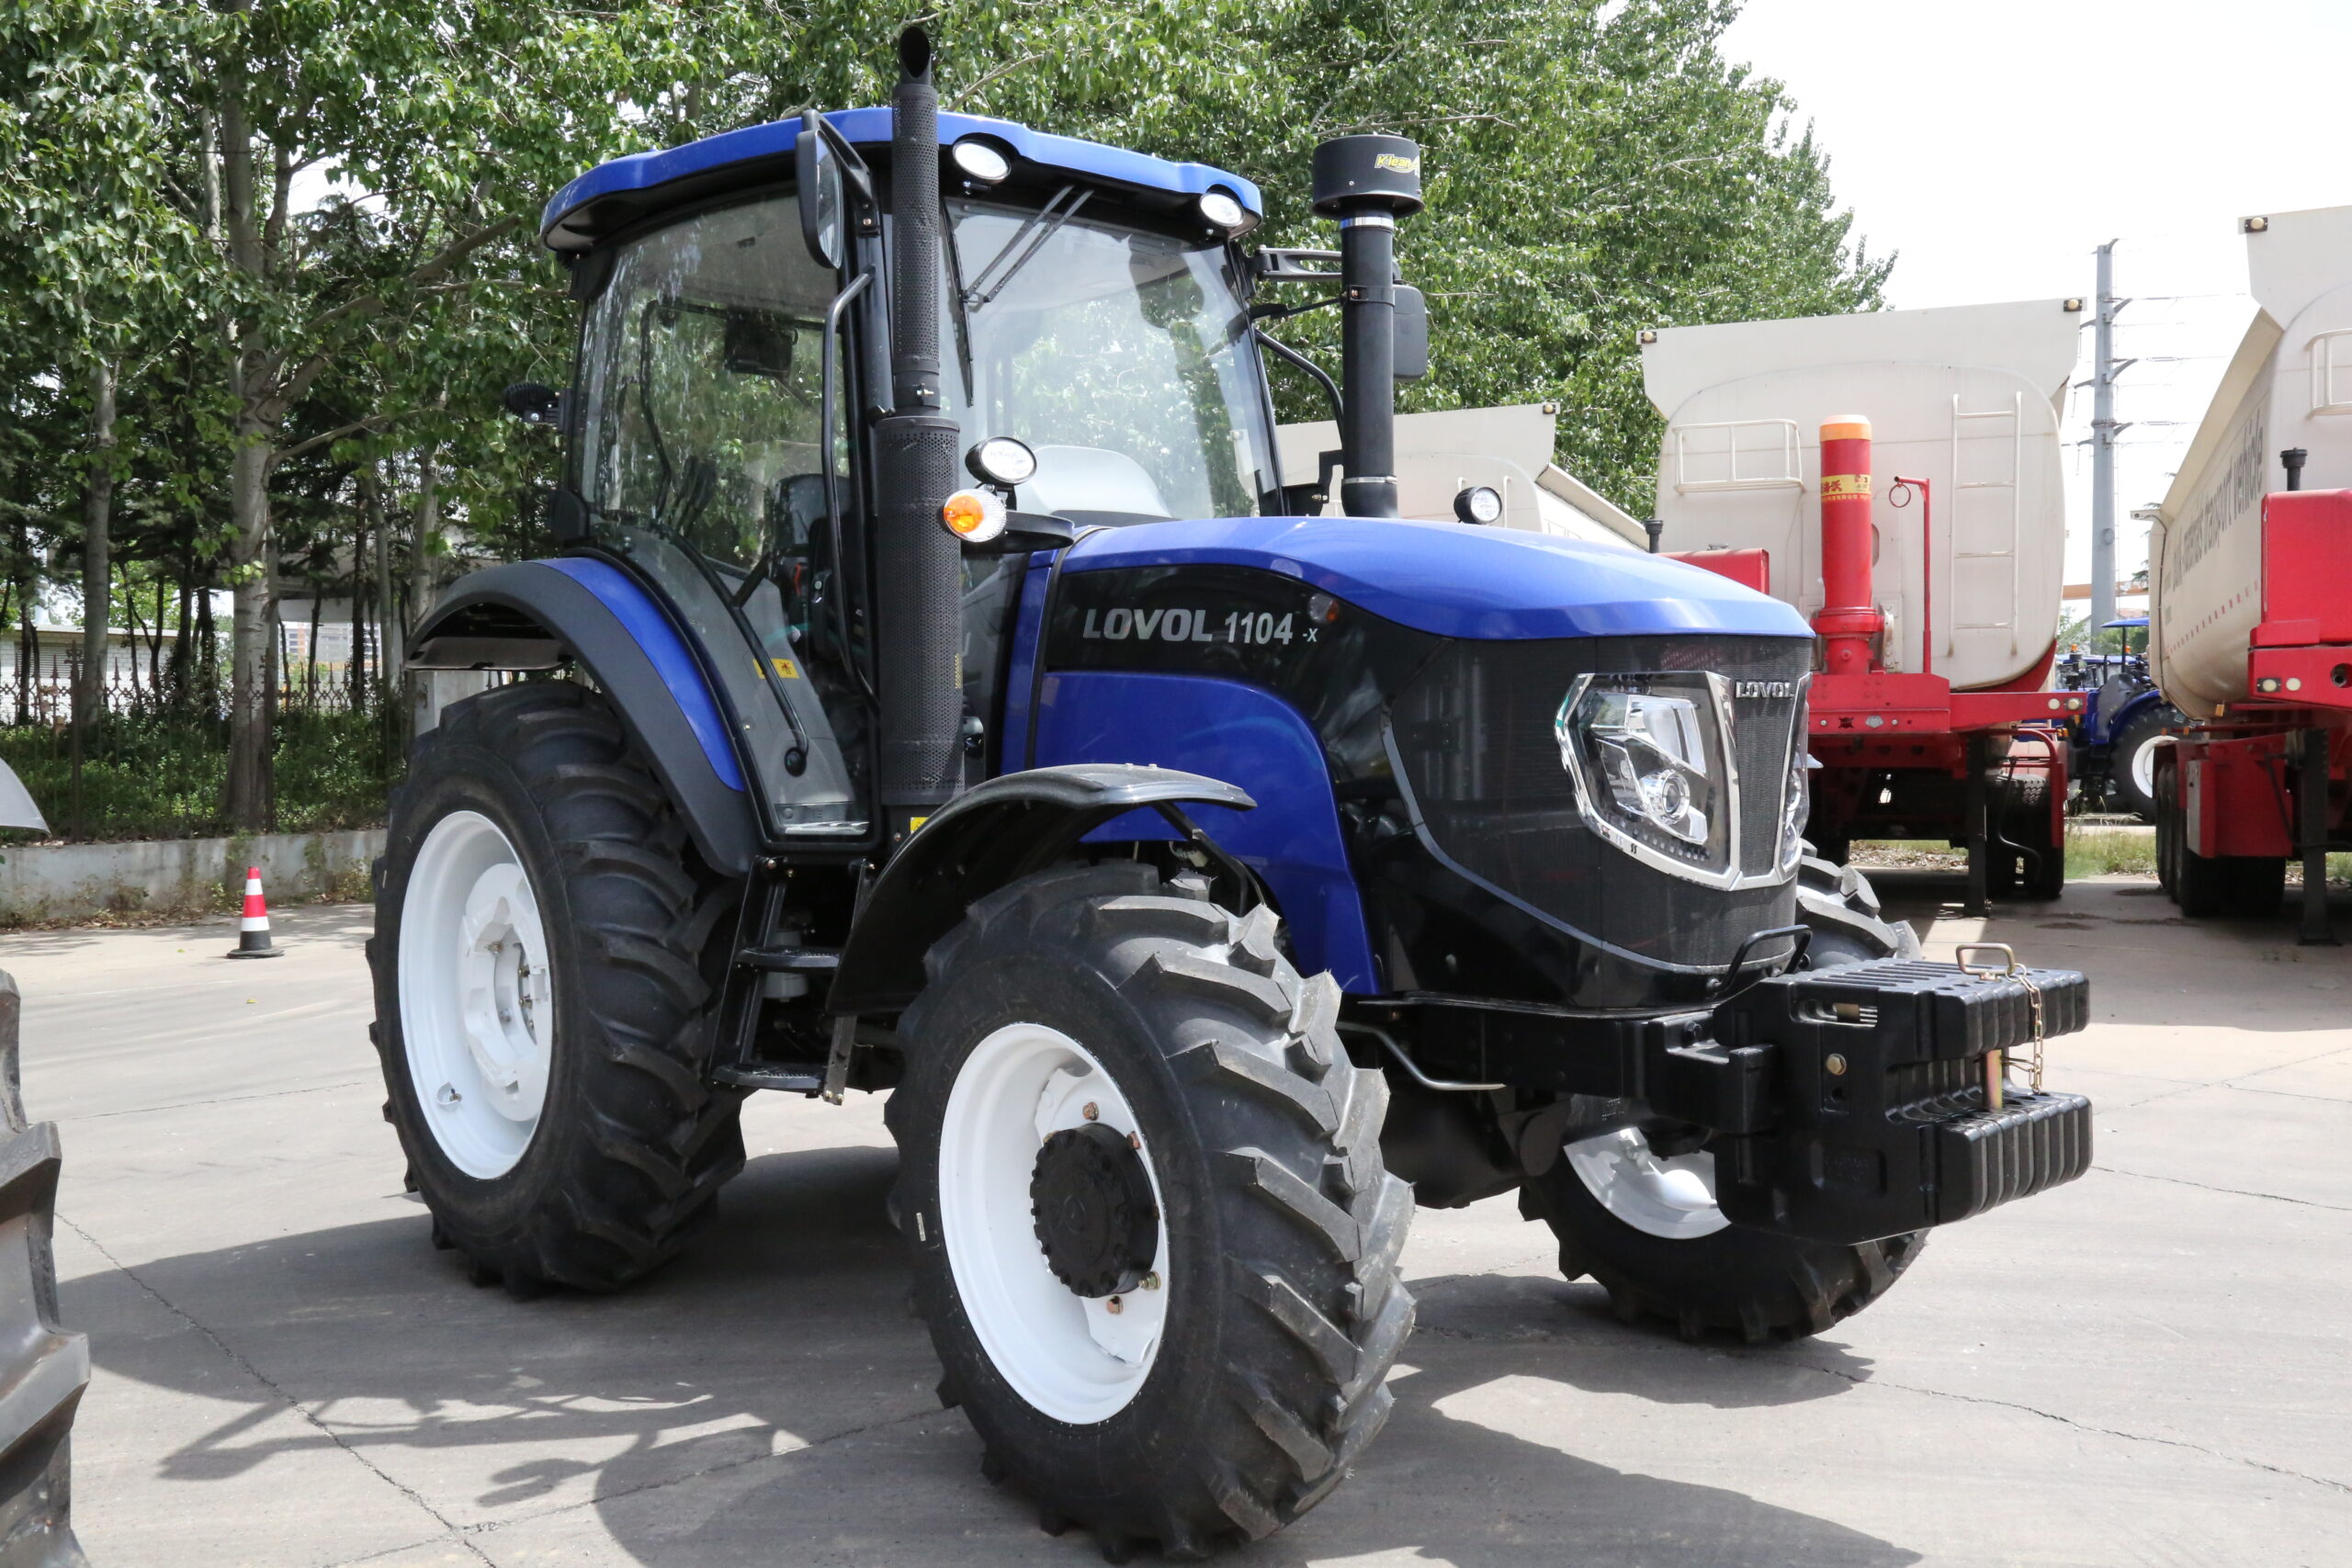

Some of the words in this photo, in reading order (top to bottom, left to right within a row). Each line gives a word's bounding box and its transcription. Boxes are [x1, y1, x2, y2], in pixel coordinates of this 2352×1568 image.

[1083, 608, 1213, 641] LOVOL
[1225, 612, 1294, 645] 1104
[1735, 681, 1794, 698] LOVOL
